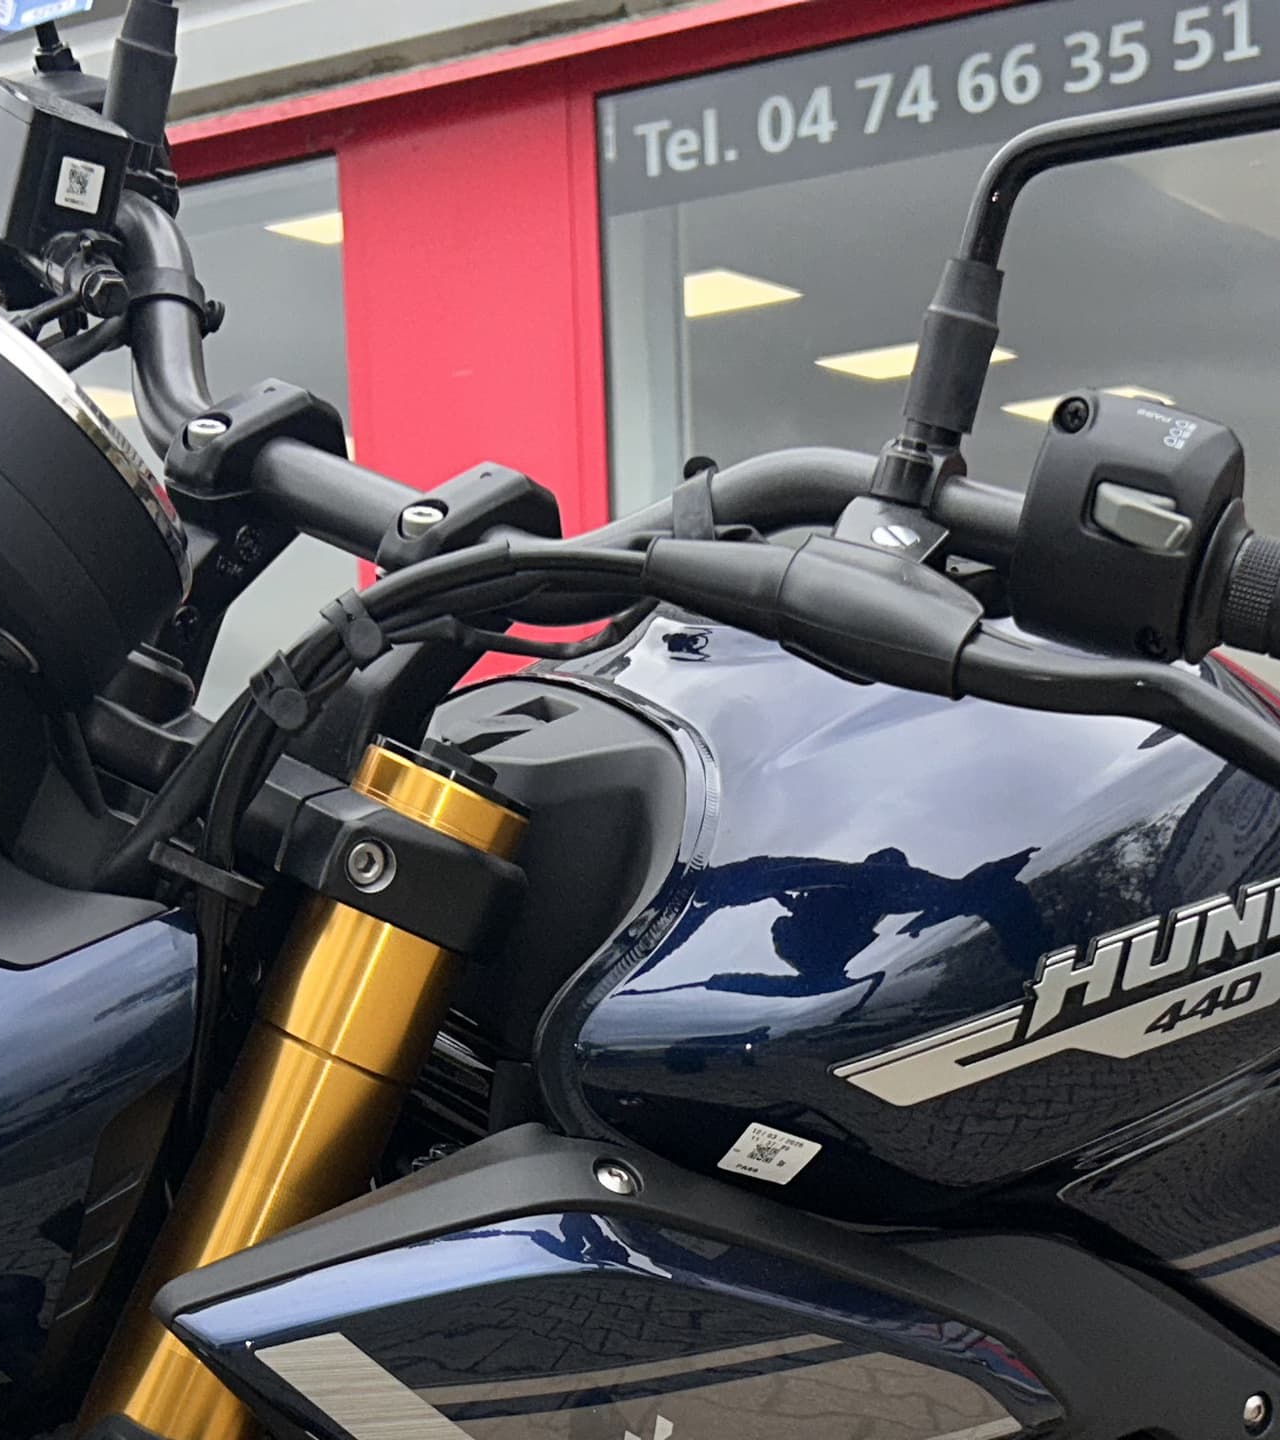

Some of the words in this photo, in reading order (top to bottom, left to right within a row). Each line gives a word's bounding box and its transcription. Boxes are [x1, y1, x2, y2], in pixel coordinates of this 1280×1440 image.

[634, 119, 738, 177] Tel.
[757, 86, 838, 152] 04
[855, 66, 938, 134] 74
[956, 45, 1041, 113] 66
[1063, 21, 1148, 94] 35
[1172, 0, 1260, 73] 51
[1145, 974, 1260, 1034] 440
